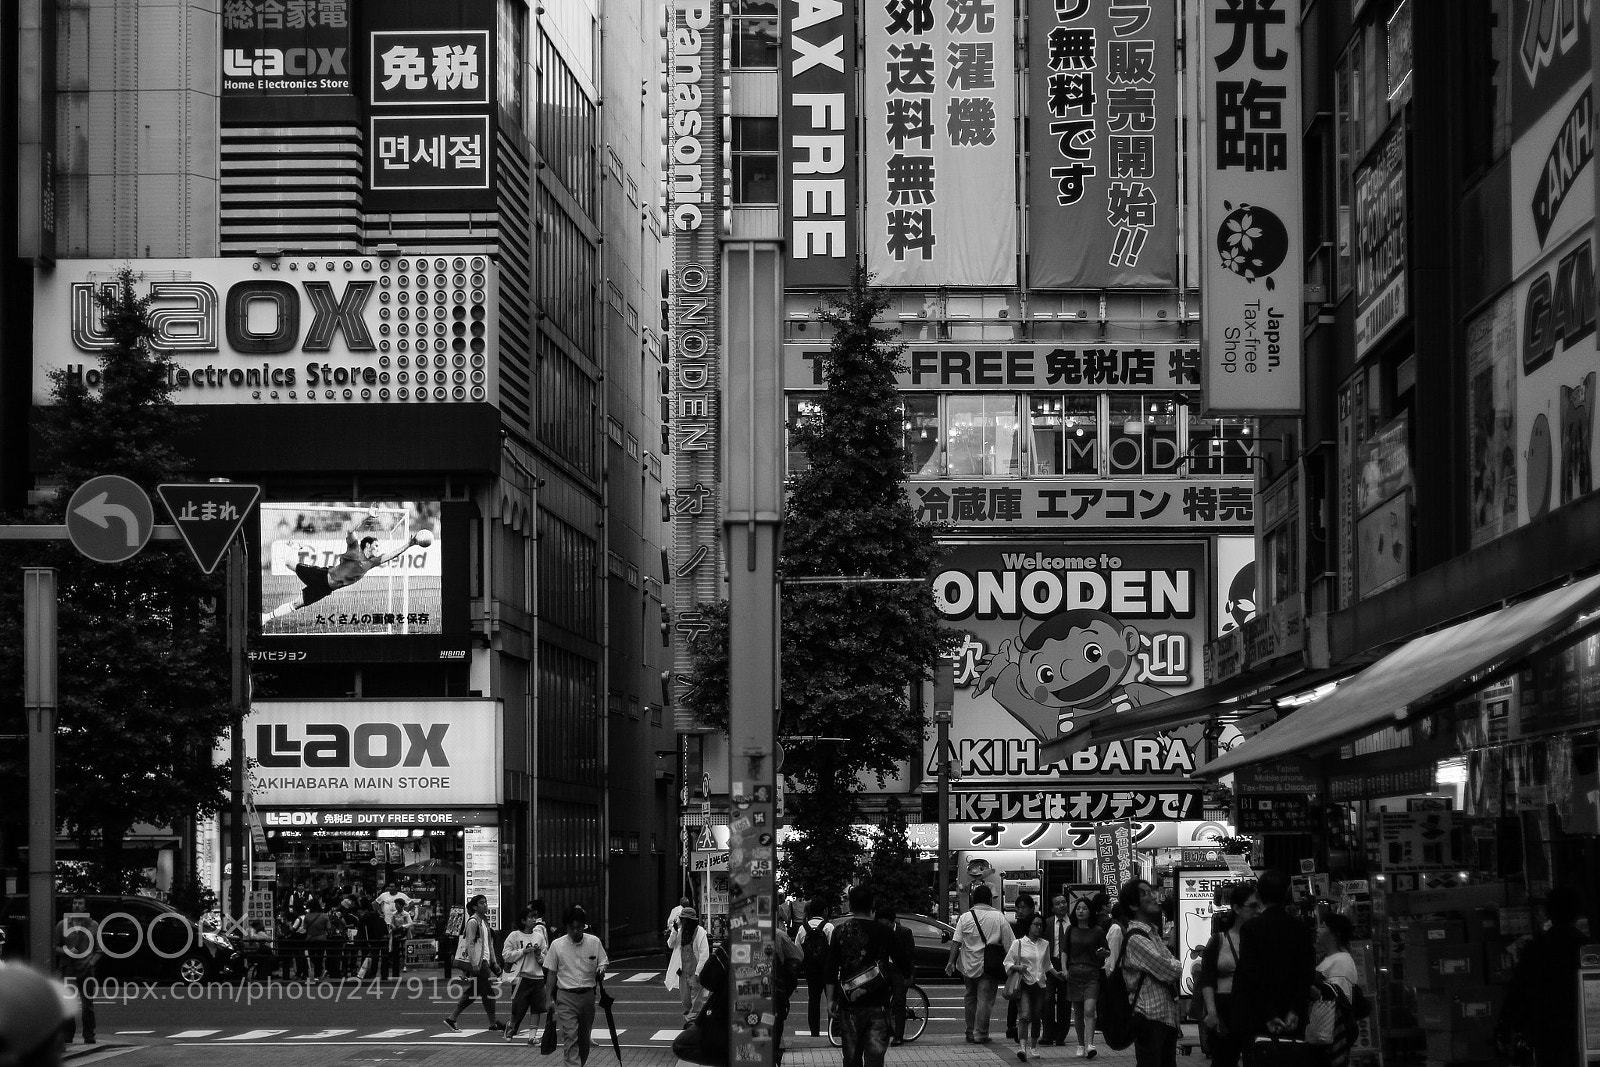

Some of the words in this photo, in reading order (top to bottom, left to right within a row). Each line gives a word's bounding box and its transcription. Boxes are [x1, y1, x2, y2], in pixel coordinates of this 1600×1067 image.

[223, 0, 348, 29] 総合家電
[224, 80, 255, 89] Home
[257, 79, 318, 89] Electronics
[320, 79, 349, 89] Store
[381, 45, 478, 91] 免税
[1214, 0, 1289, 172] 光臨
[674, 0, 712, 231] Panasonic
[379, 134, 482, 170] 면세점
[792, 93, 846, 259] FREE
[1221, 327, 1241, 374] Shop
[1244, 299, 1261, 374] Tax-free
[1267, 306, 1285, 373] Japan.
[679, 262, 709, 451] ONODEN
[912, 351, 1035, 385] FREE
[1046, 348, 1155, 385] 免税店
[152, 363, 297, 389] lectronics
[307, 362, 378, 388] Store
[179, 500, 240, 522] 止まれ
[915, 487, 1022, 521] 冷蔵庫
[1037, 488, 1171, 521] エアコン
[1183, 487, 1253, 521] 特売
[1001, 553, 1097, 570] Welcome
[1100, 553, 1122, 570] to
[933, 570, 1190, 615] ONODEN
[315, 613, 430, 625] たくさんの画像を保存
[256, 777, 349, 790] AKIHABARA
[353, 777, 393, 789] MAIN
[397, 776, 450, 789] STORE
[324, 813, 352, 824] 免税店
[358, 814, 386, 823] DUTY
[388, 813, 415, 823] FREE
[418, 813, 453, 823] STORE
